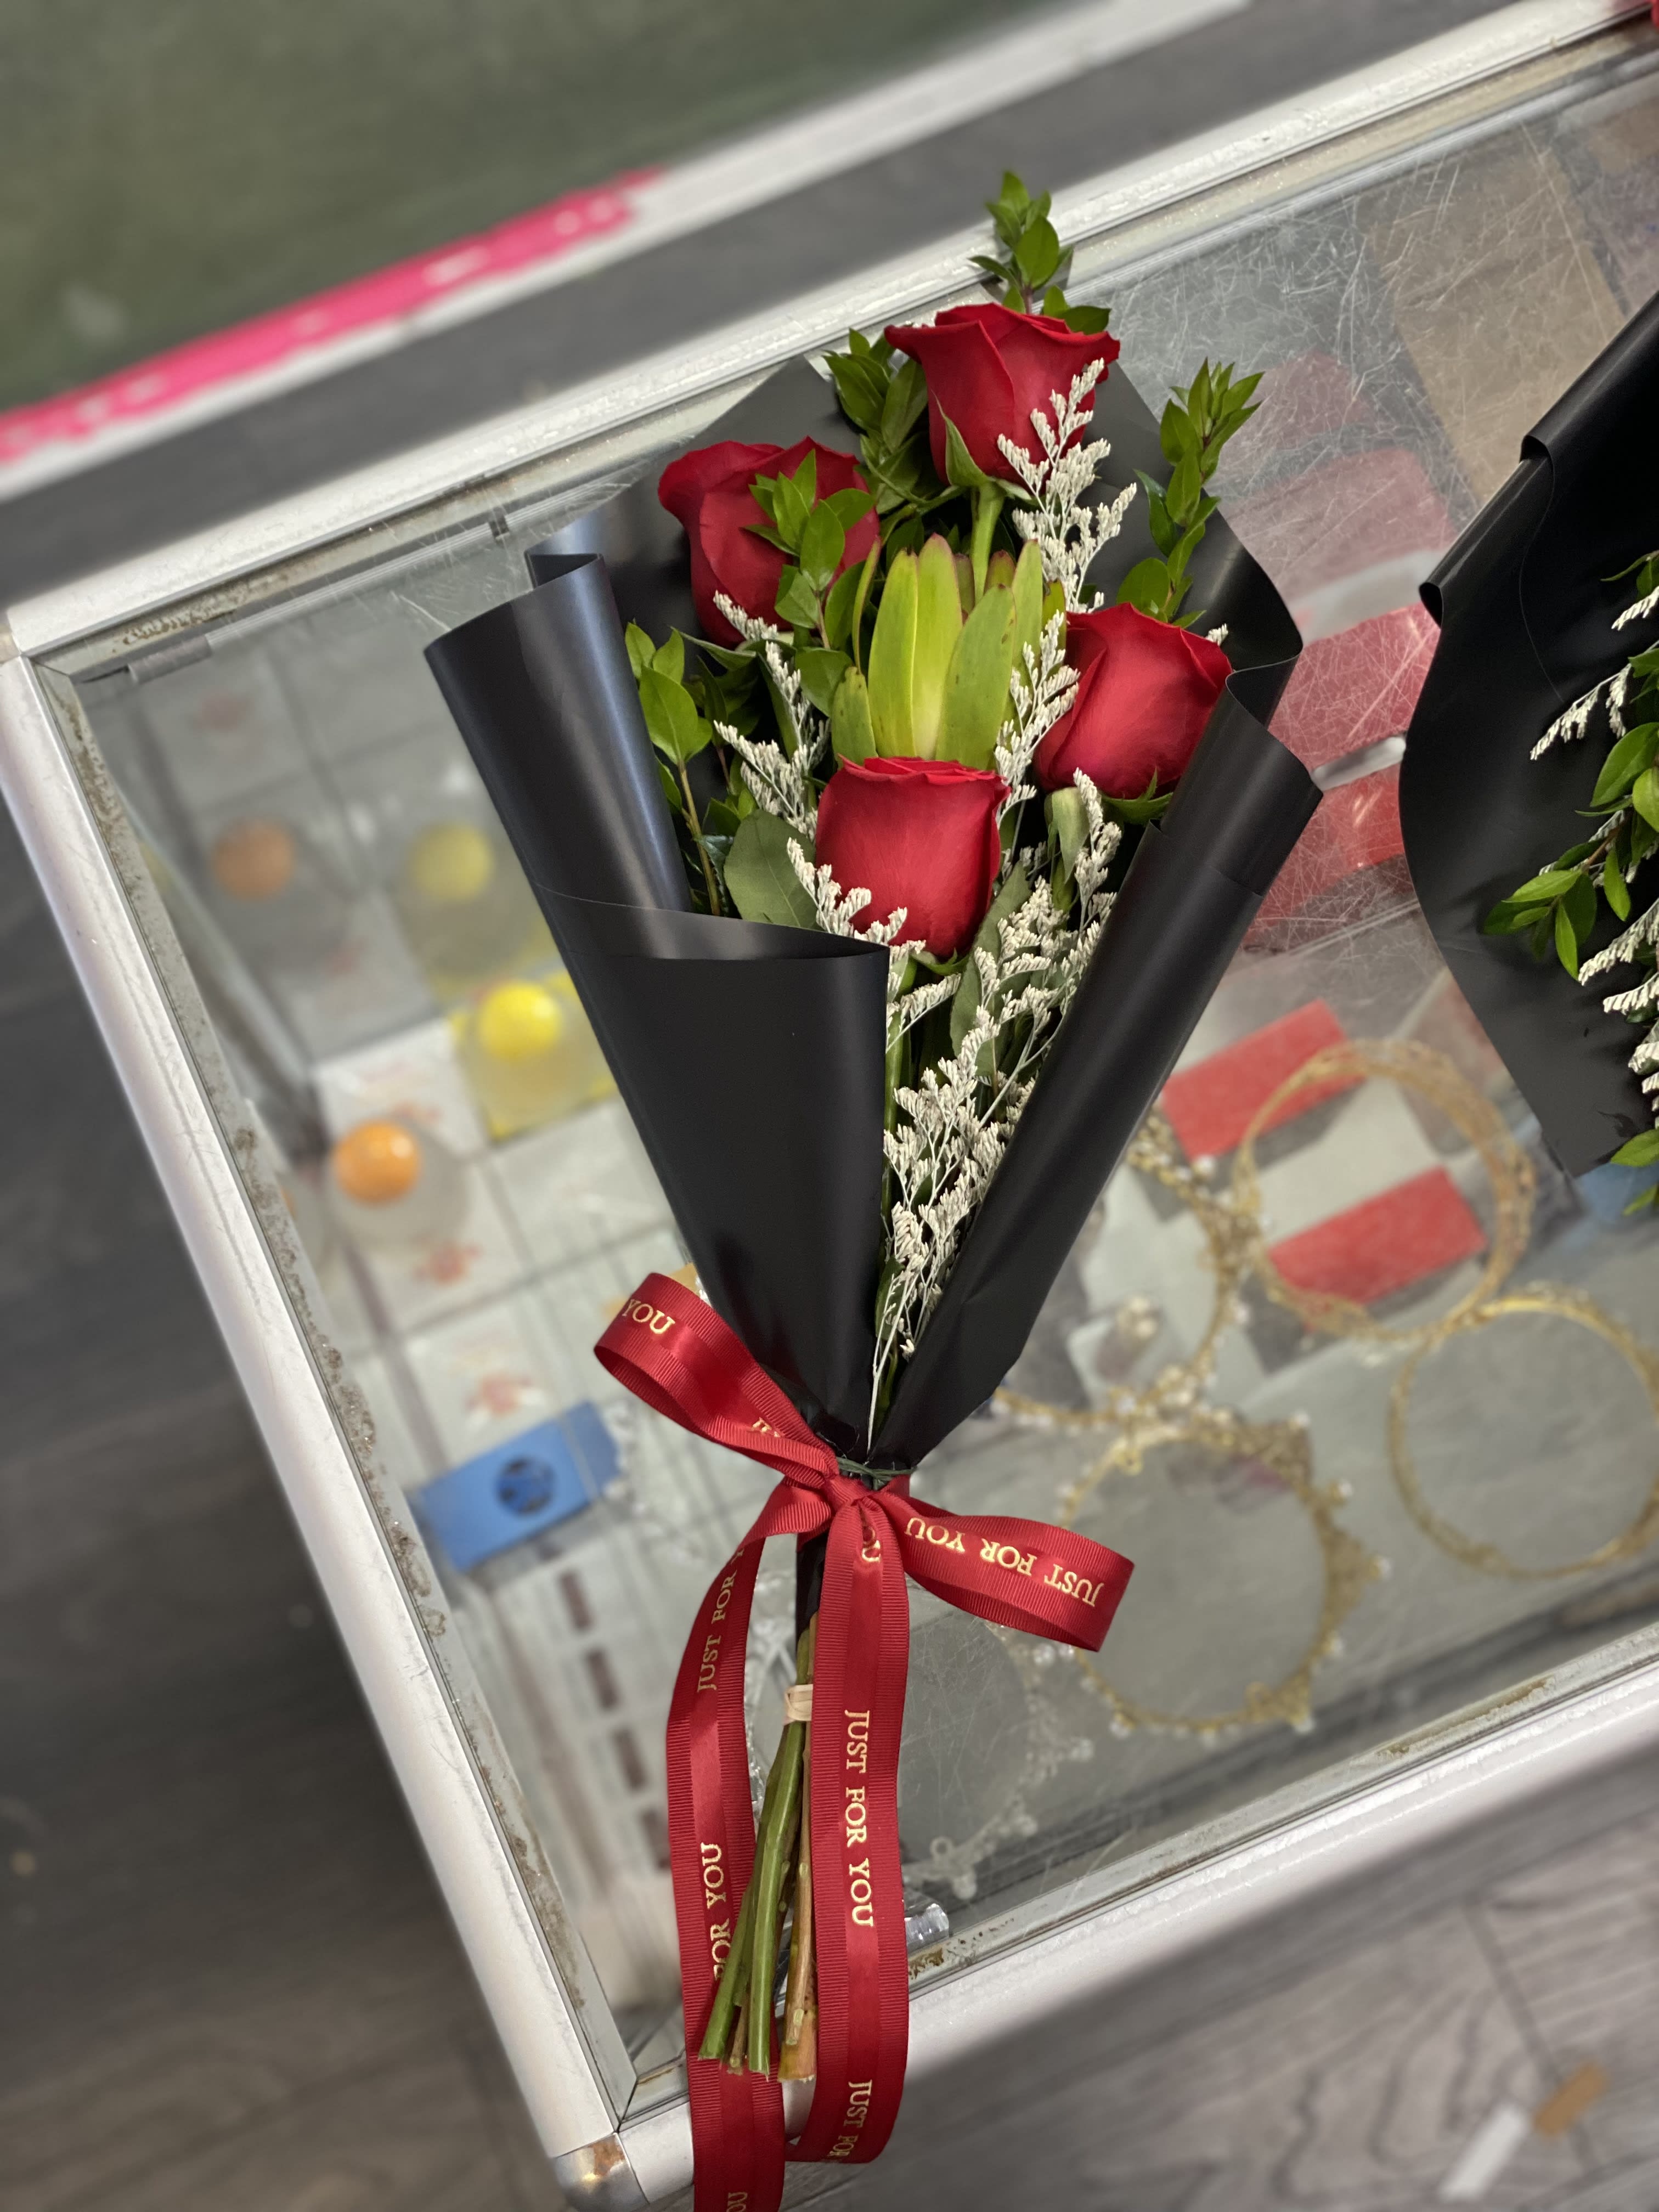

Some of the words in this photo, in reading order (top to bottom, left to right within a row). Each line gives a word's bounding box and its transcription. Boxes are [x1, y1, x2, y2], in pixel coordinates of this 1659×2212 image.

[622, 1299, 675, 1334] YOU
[904, 1517, 966, 1554] YOU
[979, 1538, 1037, 1576] FOR
[1044, 1564, 1104, 1607] JUST
[697, 1635, 721, 1694] JUST
[712, 1569, 737, 1624] FOR
[844, 1709, 870, 1774] JUST
[845, 1786, 867, 1848] FOR
[700, 1842, 727, 1909] YOU
[849, 1858, 874, 1927] YOU
[843, 2079, 873, 2128] JUST
[827, 2134, 859, 2157] FOR
